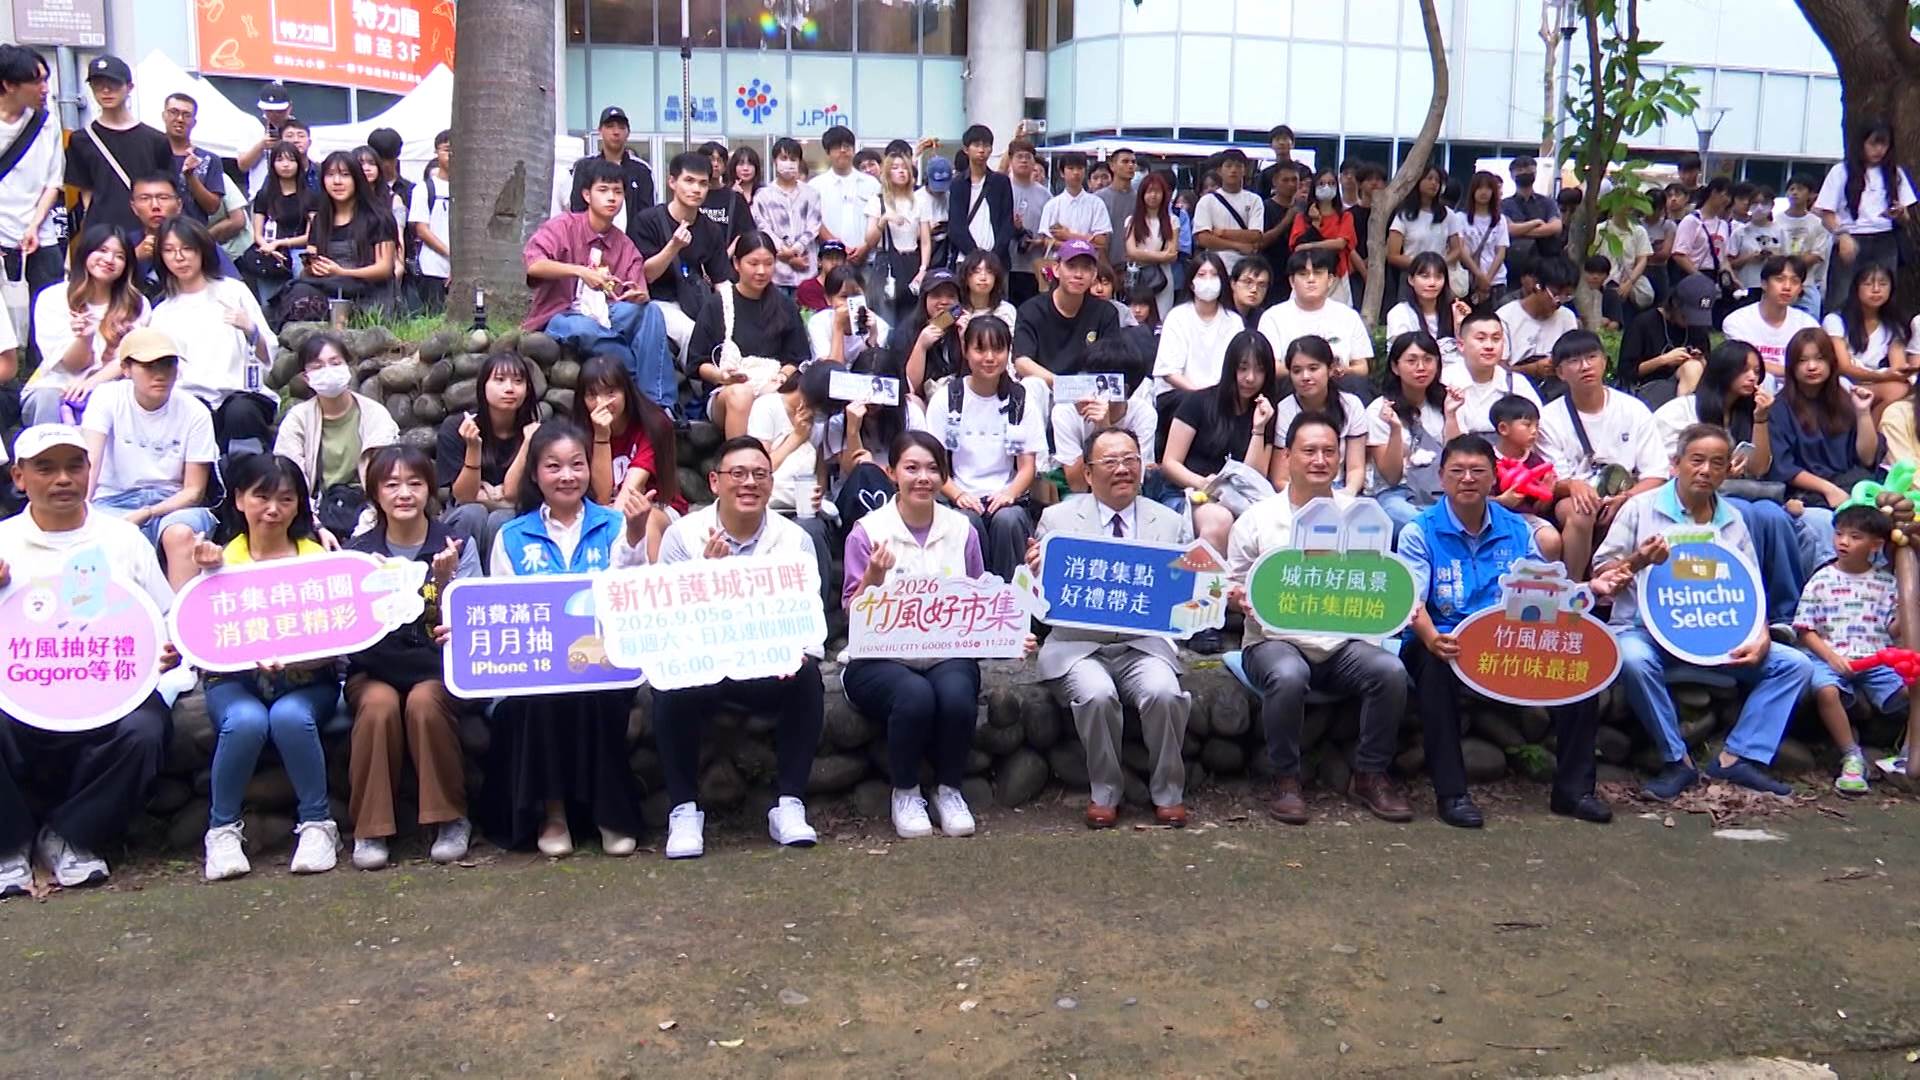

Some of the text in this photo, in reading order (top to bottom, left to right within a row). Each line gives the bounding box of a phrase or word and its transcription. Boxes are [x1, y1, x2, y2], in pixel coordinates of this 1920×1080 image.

[1064, 555, 1154, 588] 消費集點
[1280, 564, 1387, 592] 城市好風景
[211, 573, 354, 616] 市集串商圈
[607, 563, 808, 612] 新竹護城河畔
[896, 578, 939, 595] 2026
[1059, 583, 1151, 616] 好禮帶走
[1658, 583, 1745, 607] Hsinchu
[466, 603, 551, 626] 消費滿百
[856, 588, 1024, 637] 竹風好市集
[1279, 591, 1385, 620] 從市集開始
[1670, 607, 1739, 629] Select
[214, 602, 359, 649] 消費更精彩
[1493, 625, 1584, 655] 竹風嚴選
[8, 635, 136, 660] 竹風抽好禮
[469, 625, 553, 657] 月月抽
[900, 643, 920, 652] CITY
[922, 640, 953, 651] GOODS
[7, 660, 137, 686] Gogoro等你
[533, 658, 552, 672] 18
[1477, 651, 1591, 683] 新竹味最讚
